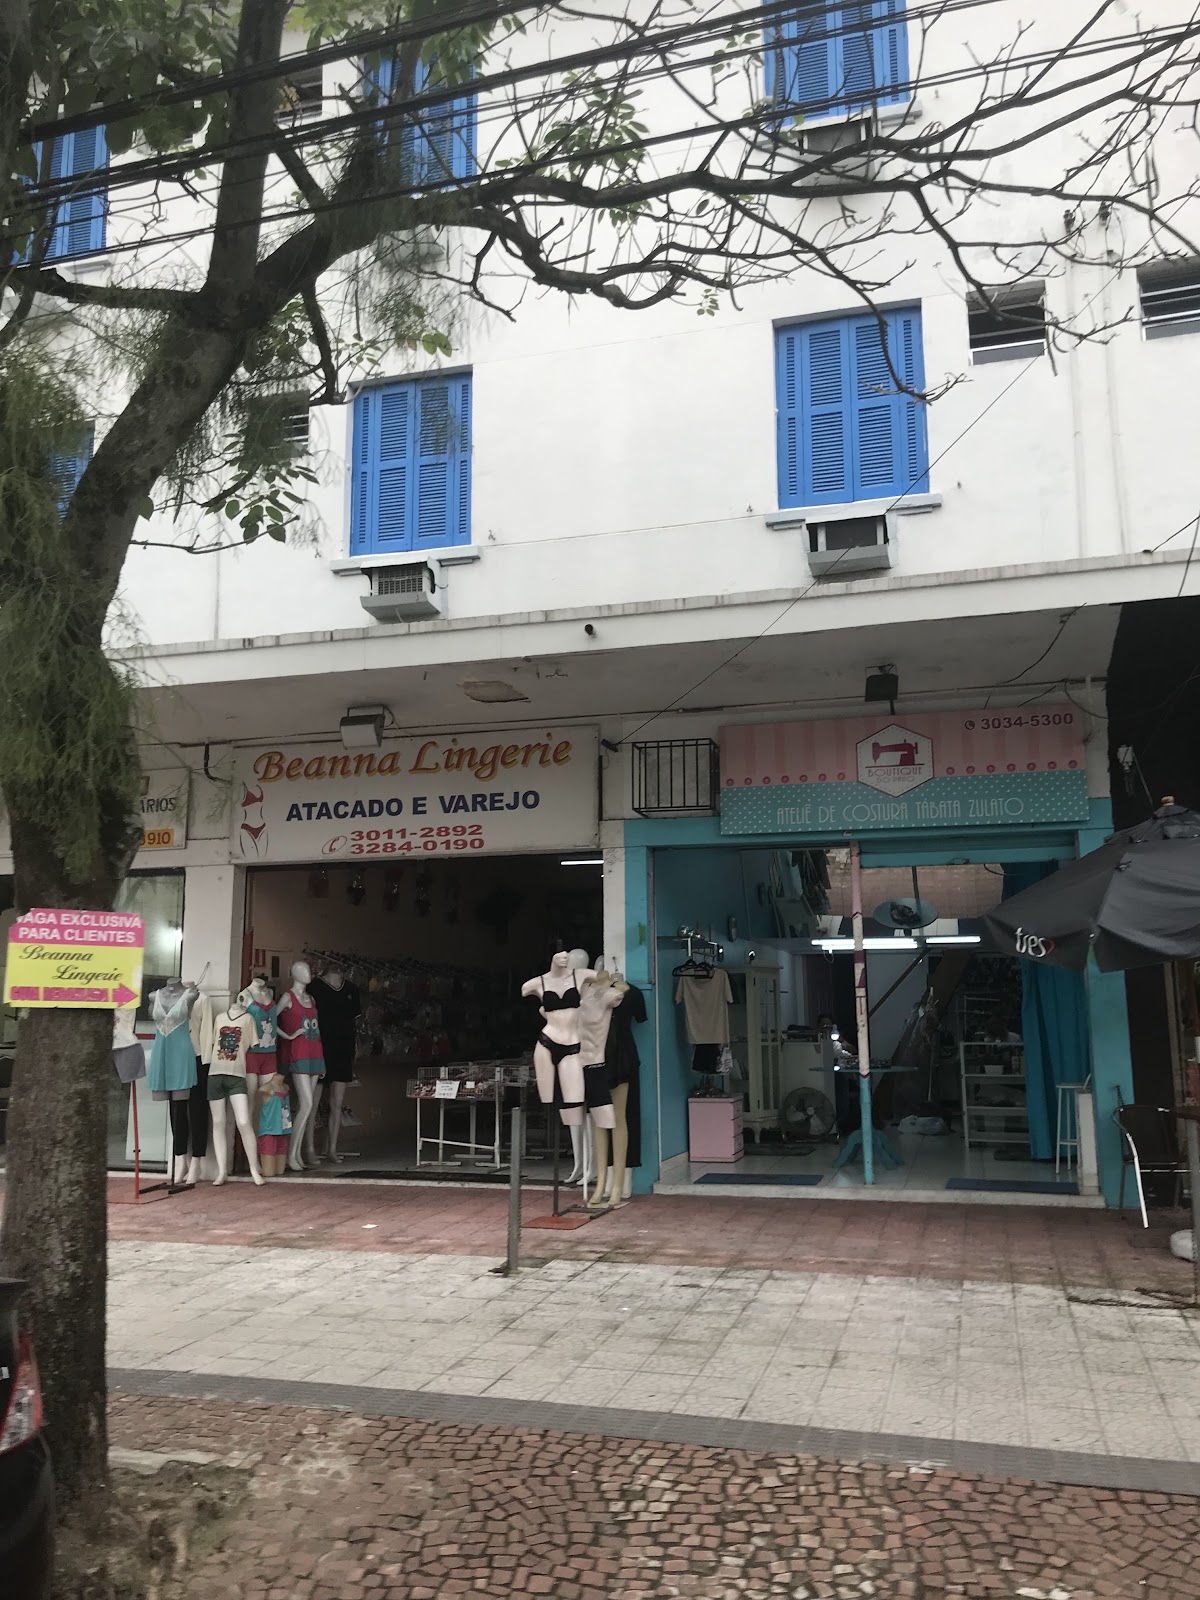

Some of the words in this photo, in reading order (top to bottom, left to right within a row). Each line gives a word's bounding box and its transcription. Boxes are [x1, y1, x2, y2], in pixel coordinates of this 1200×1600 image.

[981, 713, 1074, 731] 3034-5300
[253, 750, 402, 784] Beanna
[409, 732, 573, 783] Lingerie
[868, 766, 922, 778] BOUTIQUE
[286, 798, 403, 822] ATACADO
[412, 796, 428, 815] E
[439, 790, 541, 813] VAREJO
[818, 806, 836, 824] DE
[842, 802, 909, 822] COSTURA
[915, 798, 961, 819] TÁBATA
[968, 797, 1024, 818] ZULATO
[350, 825, 484, 841] 3011-2892
[350, 838, 485, 855] 3284-0190
[60, 914, 142, 928] EXCLUSIVA
[18, 927, 61, 940] PARA
[64, 929, 136, 943] CLIENTES
[19, 945, 94, 962] Beanna
[52, 965, 124, 985] Lingerie
